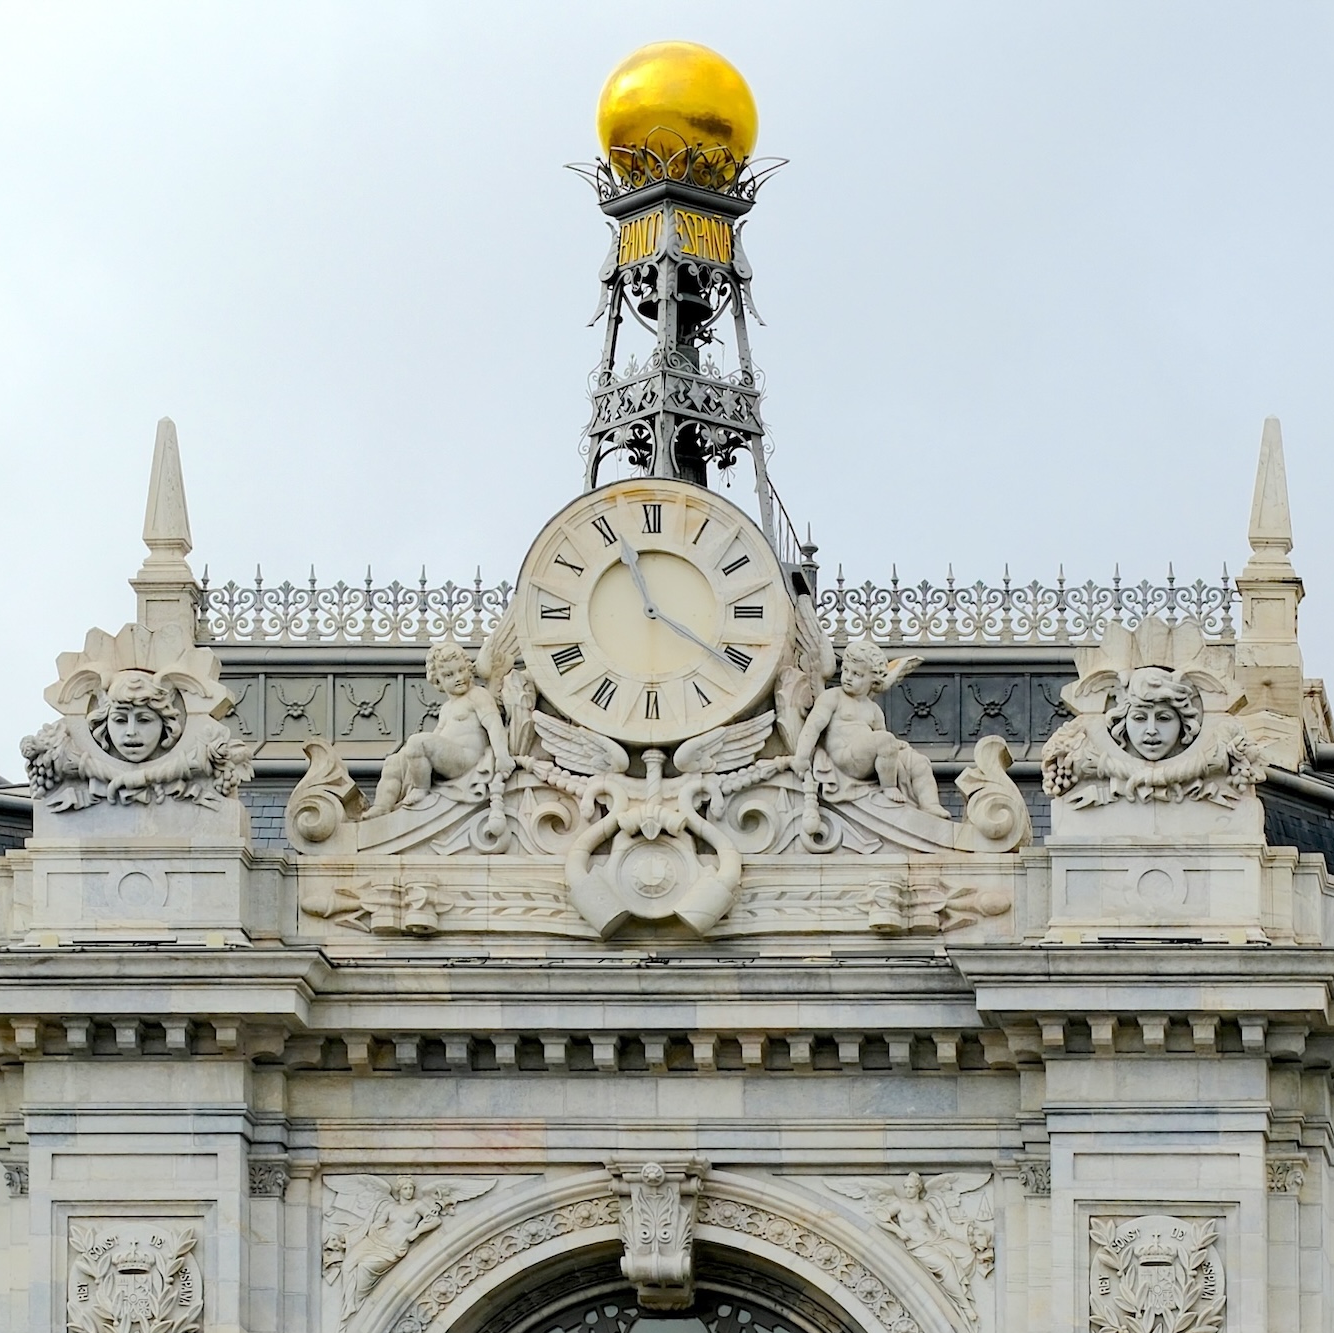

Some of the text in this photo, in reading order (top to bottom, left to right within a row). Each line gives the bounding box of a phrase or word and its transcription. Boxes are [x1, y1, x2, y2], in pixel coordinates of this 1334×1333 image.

[619, 211, 662, 266] BANCO
[591, 515, 618, 547] XI
[642, 504, 662, 533] XII
[692, 518, 709, 545] I
[554, 554, 584, 577] X
[722, 554, 750, 576] II
[541, 604, 571, 620] IX
[734, 606, 763, 619] III
[551, 643, 586, 676] VIII
[590, 677, 618, 710] VII
[645, 691, 660, 719] VI
[692, 681, 713, 708] V
[77, 1281, 89, 1302] REY
[1098, 1274, 1111, 1295] REY
